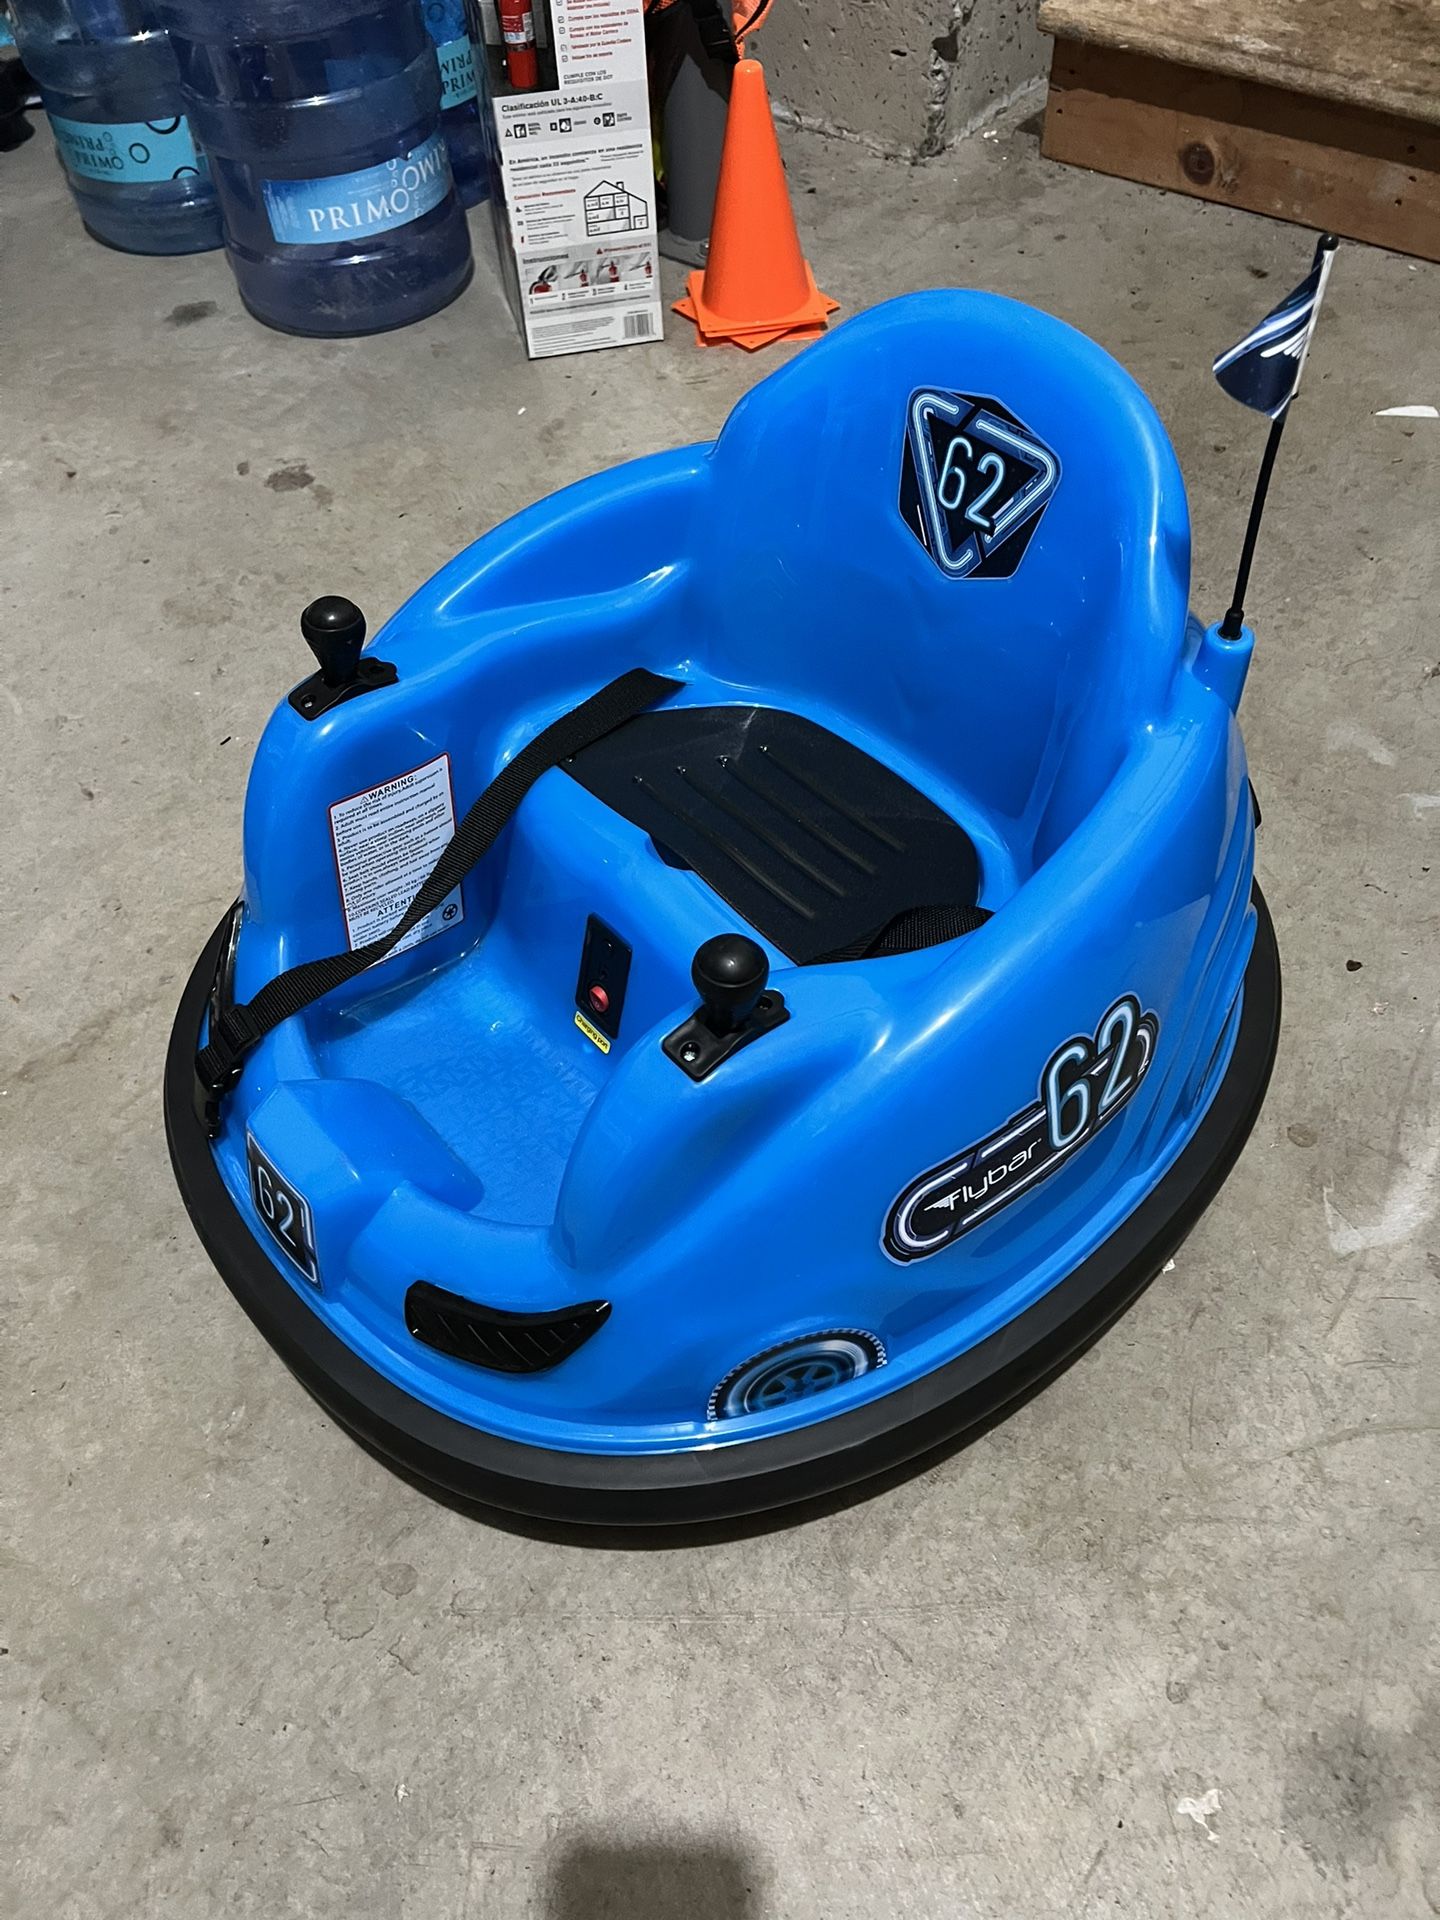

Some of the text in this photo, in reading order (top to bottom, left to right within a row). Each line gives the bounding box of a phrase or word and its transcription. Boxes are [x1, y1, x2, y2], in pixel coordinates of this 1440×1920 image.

[500, 99, 549, 112] Clasificación
[550, 98, 561, 106] UL
[308, 187, 410, 233] PRIMO
[938, 436, 1006, 528] 62
[368, 773, 417, 800] WARNING:
[376, 893, 416, 917] ATTENTI
[1047, 999, 1135, 1150] 62
[257, 1165, 297, 1247] 62
